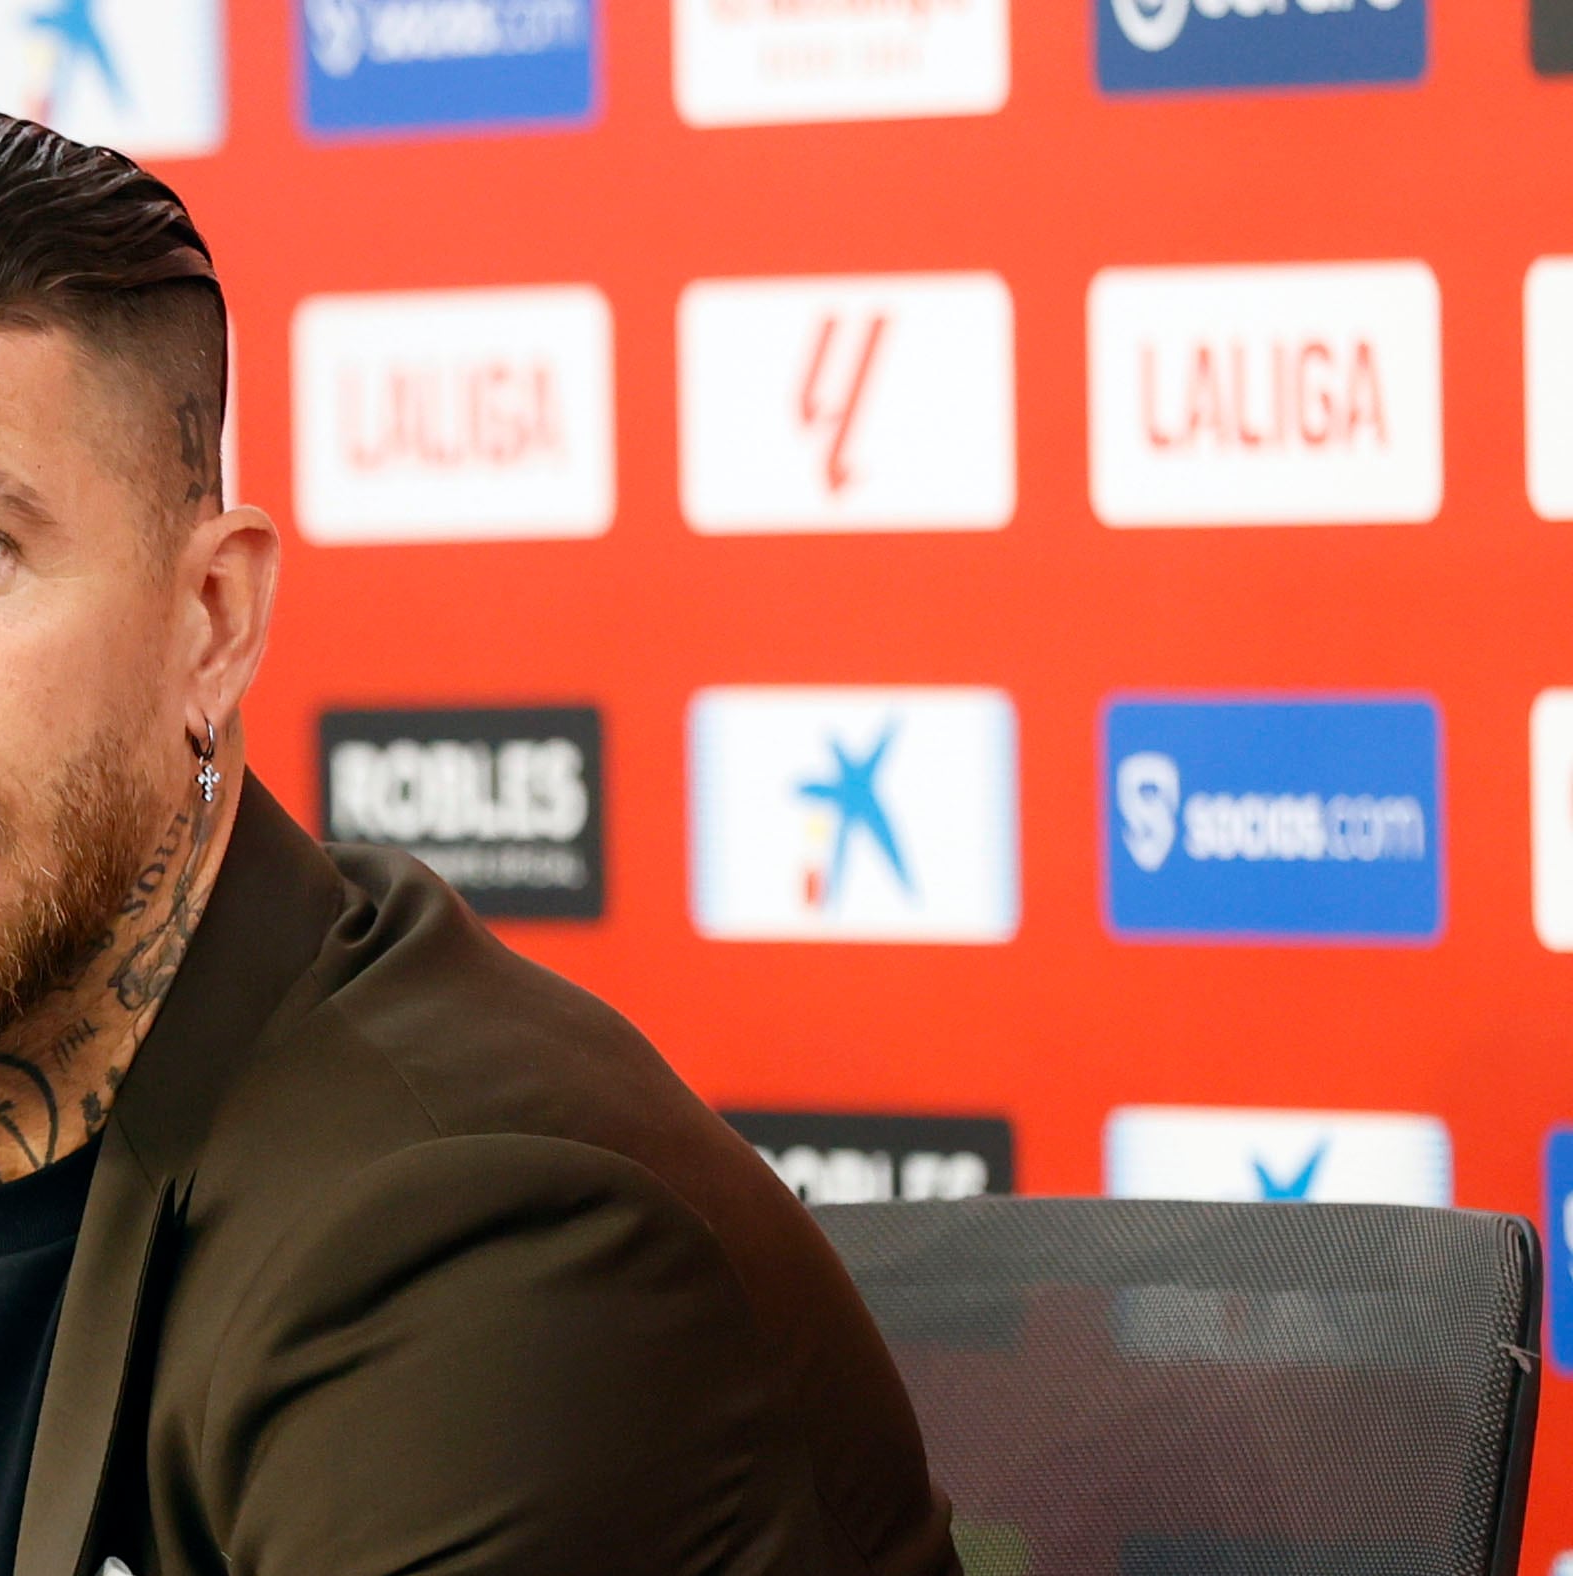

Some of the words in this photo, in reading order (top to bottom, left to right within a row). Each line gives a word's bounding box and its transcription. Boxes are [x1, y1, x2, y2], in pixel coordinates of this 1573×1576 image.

[337, 352, 571, 476] LALIGA
[1137, 338, 1389, 455] LALIGA
[327, 736, 591, 844] ROBLES
[1181, 790, 1427, 862] socios.com
